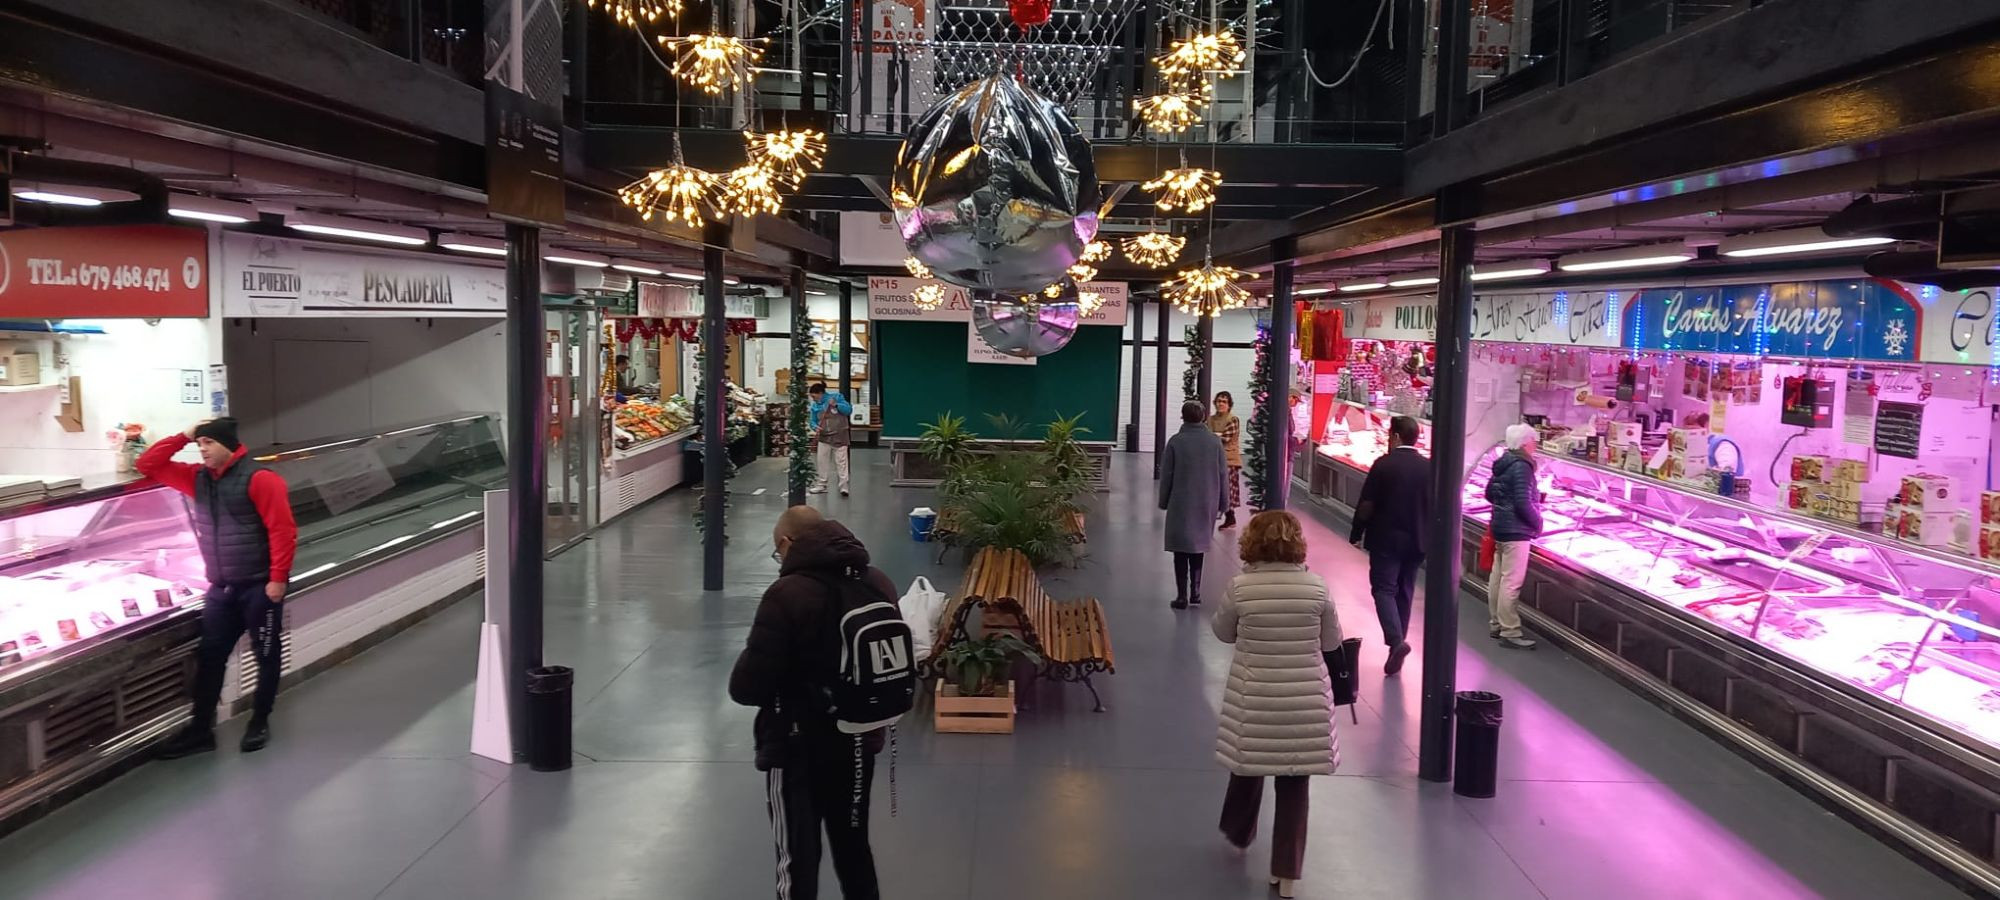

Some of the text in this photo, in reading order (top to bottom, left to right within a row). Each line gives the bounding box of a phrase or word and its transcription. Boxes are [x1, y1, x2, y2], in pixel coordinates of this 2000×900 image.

[79, 263, 110, 291] 679
[112, 265, 142, 290] 468
[144, 268, 170, 292] 474
[242, 271, 301, 292] EL PUERTO
[874, 295, 907, 303] FRUTOS
[875, 307, 922, 316] GOLOSINAS
